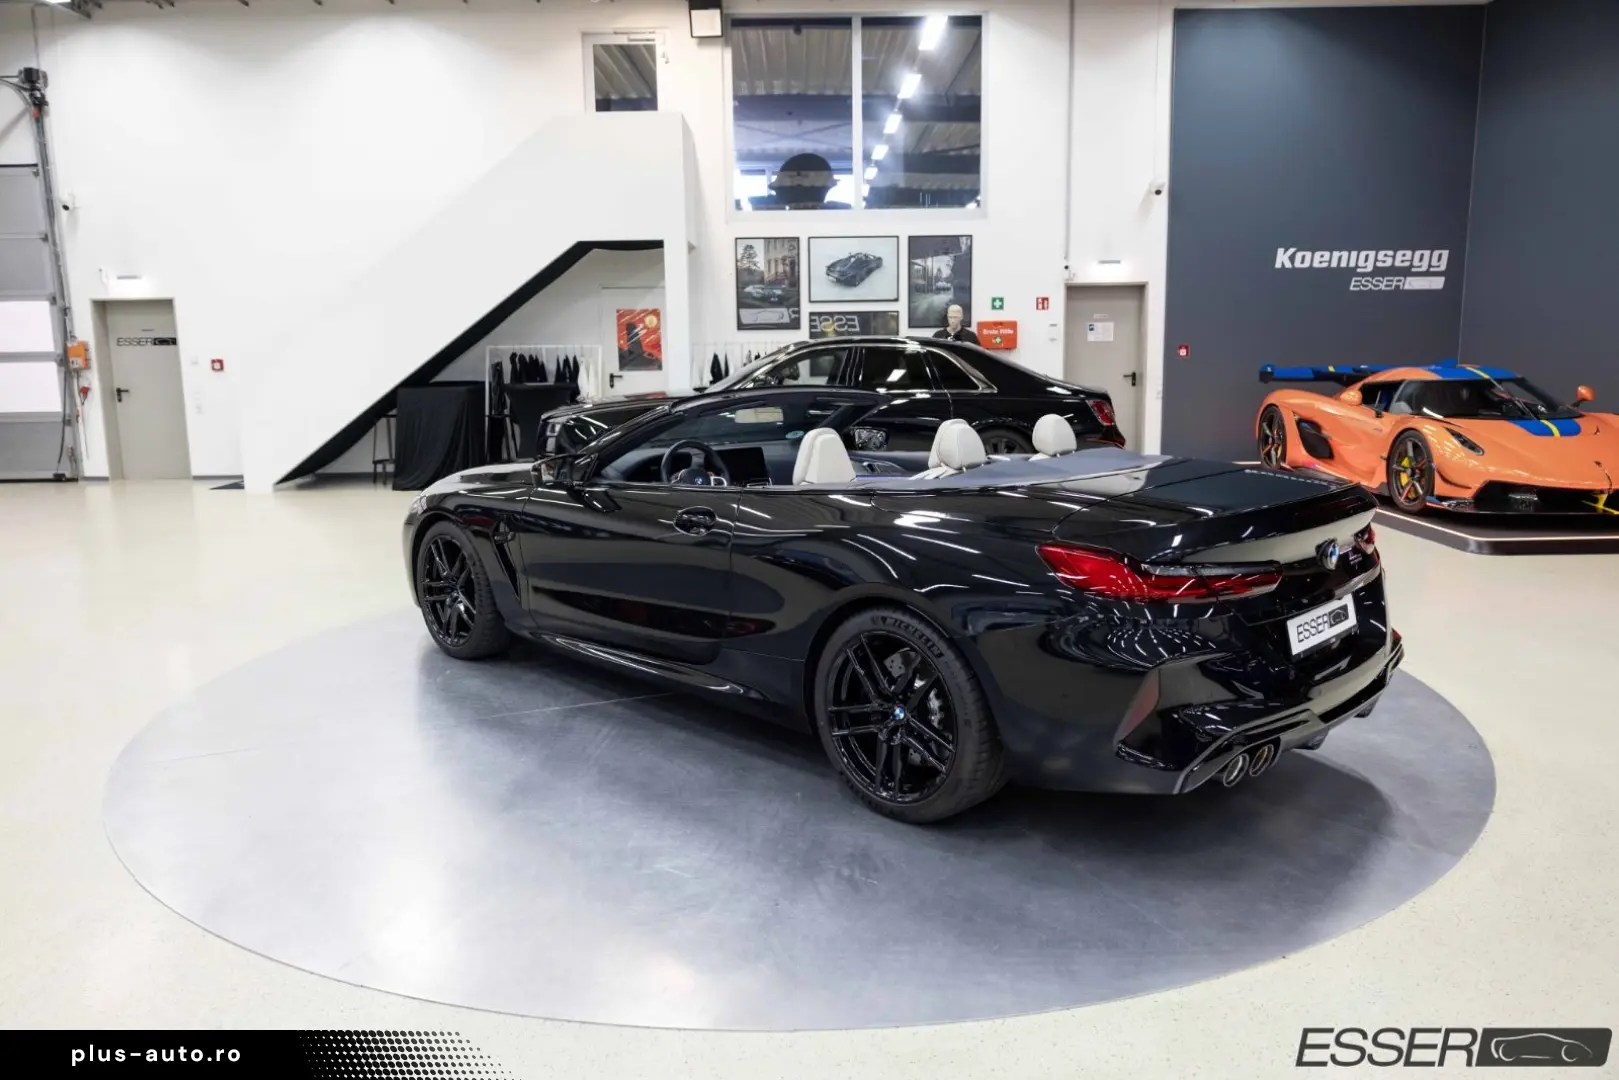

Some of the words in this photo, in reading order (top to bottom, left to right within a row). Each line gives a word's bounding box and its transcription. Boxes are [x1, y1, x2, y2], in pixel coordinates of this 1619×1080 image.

[1275, 248, 1449, 272] Koenigsegg
[1350, 276, 1404, 290] ESSER
[117, 337, 153, 346] ESSER
[1296, 613, 1330, 643] ESSER
